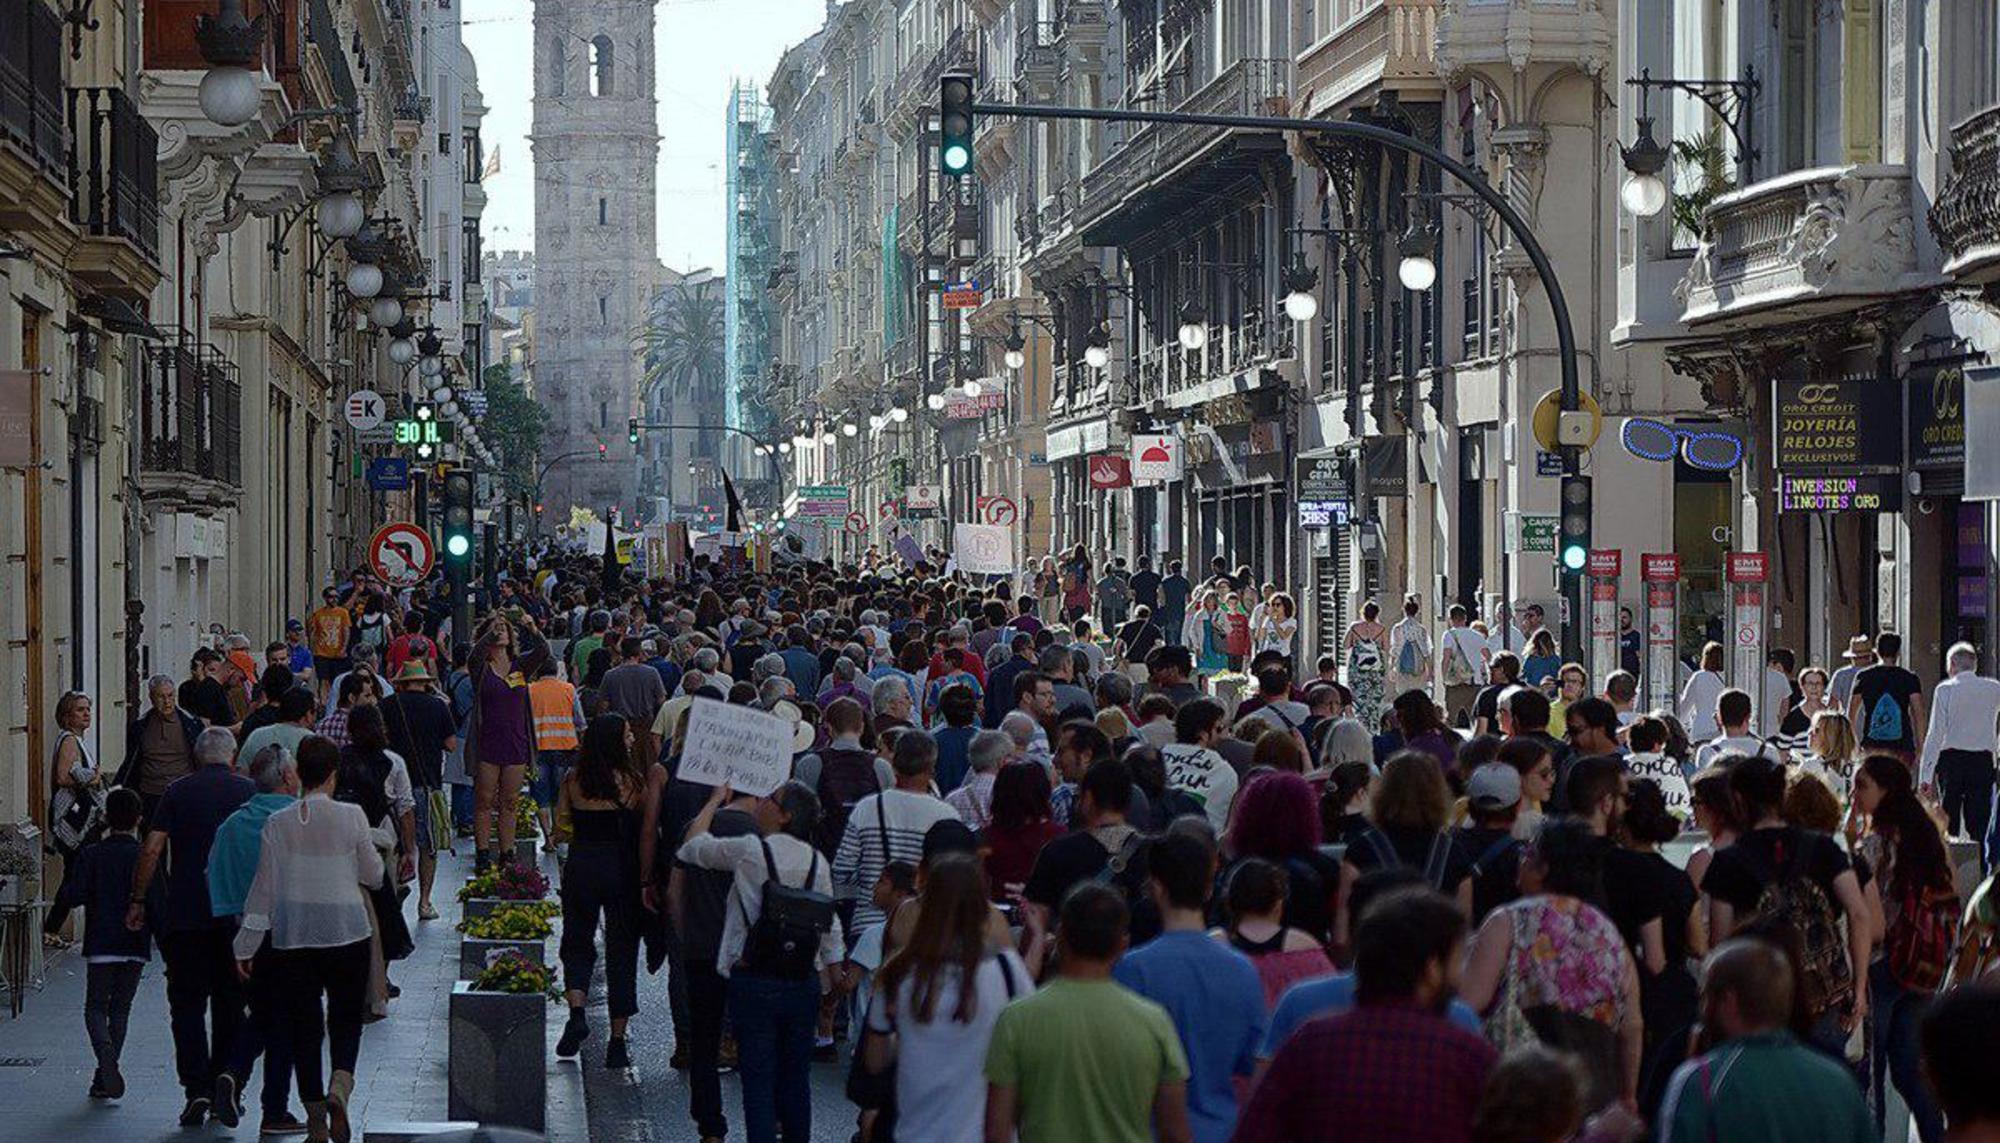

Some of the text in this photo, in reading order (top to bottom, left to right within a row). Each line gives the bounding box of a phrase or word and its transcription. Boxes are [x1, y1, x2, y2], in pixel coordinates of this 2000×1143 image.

[350, 399, 377, 417] EK
[1782, 404, 1808, 413] ORO
[1783, 416, 1856, 432] JOYERÍA
[1782, 436, 1856, 448] RELOJES
[1782, 453, 1856, 463] EXCLUSIVOS
[1316, 459, 1340, 470] ORO
[1309, 469, 1340, 480] GEMA
[1784, 479, 1857, 493] INVERSION
[1784, 495, 1880, 509] LINGOTES ORO
